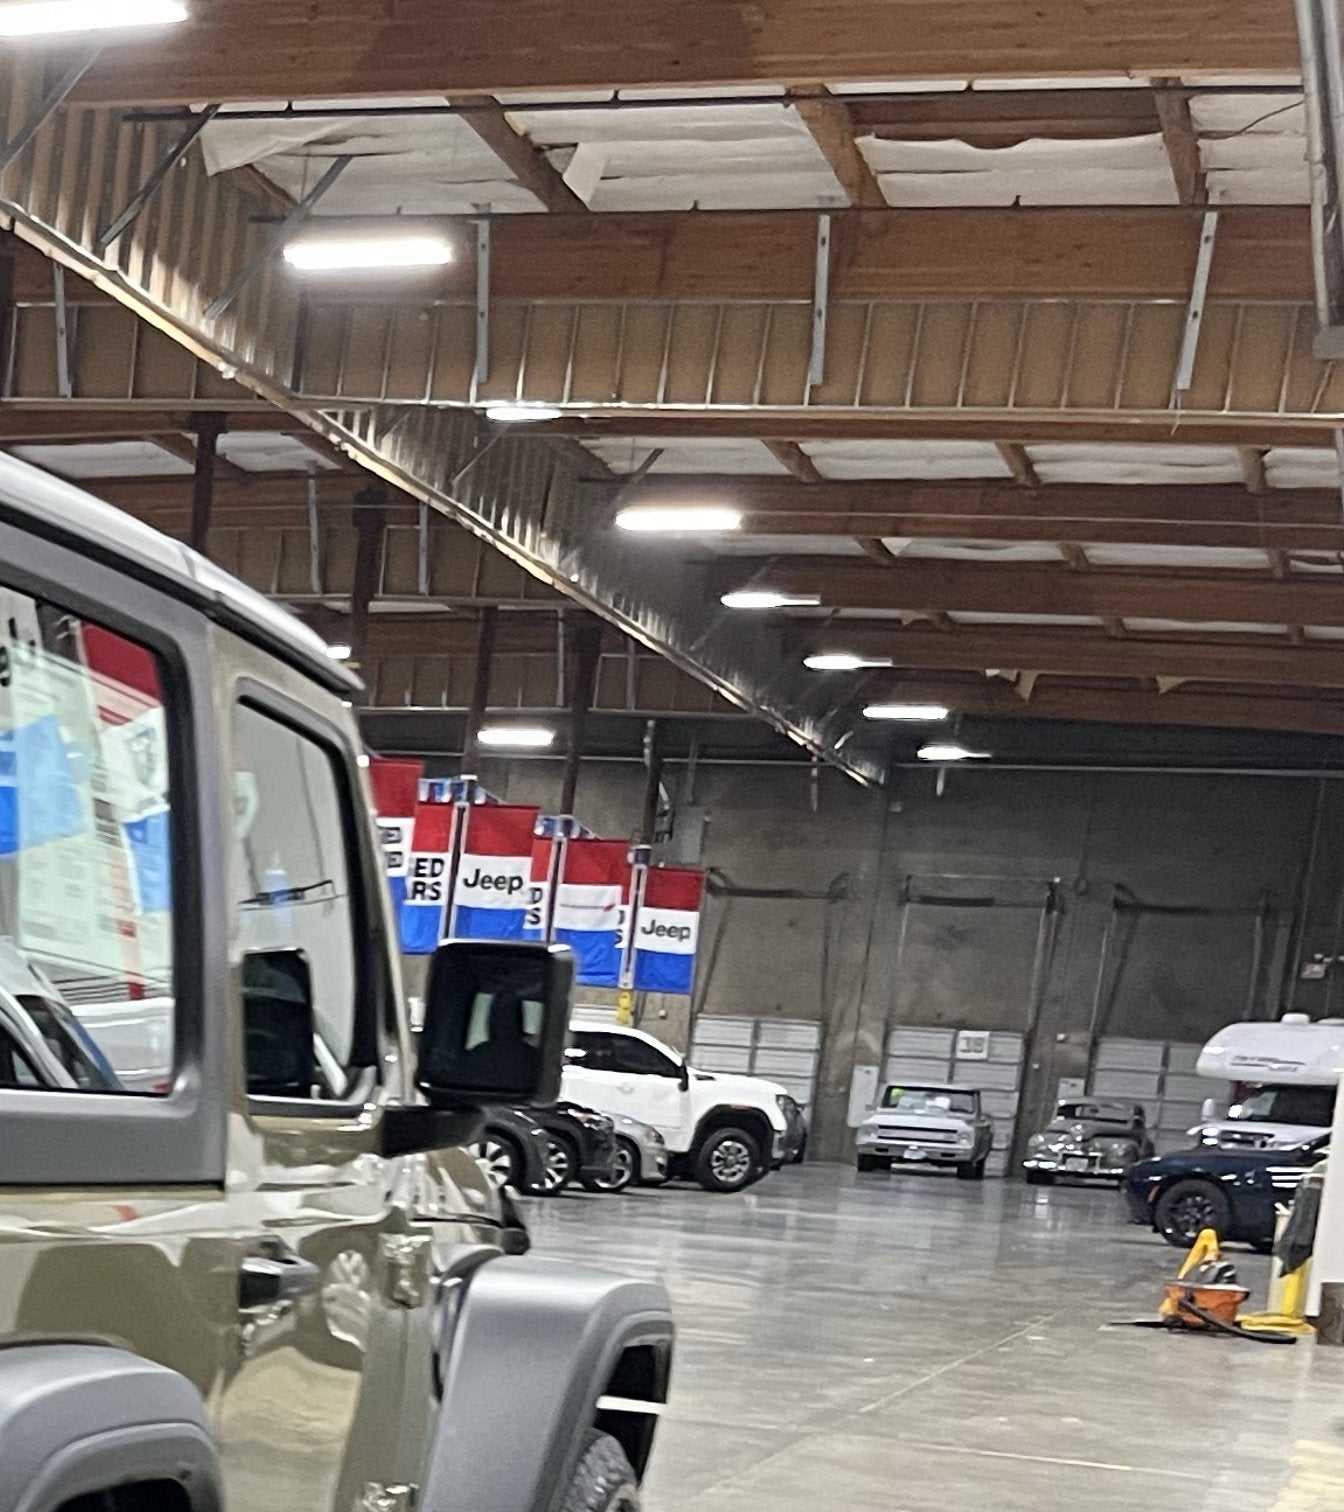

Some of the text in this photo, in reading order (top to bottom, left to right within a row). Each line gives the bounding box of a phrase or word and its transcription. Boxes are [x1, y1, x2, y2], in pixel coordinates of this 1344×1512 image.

[412, 857, 445, 878] ED
[412, 880, 442, 901] RS
[462, 868, 523, 895] Jeep
[641, 920, 691, 942] Jeep
